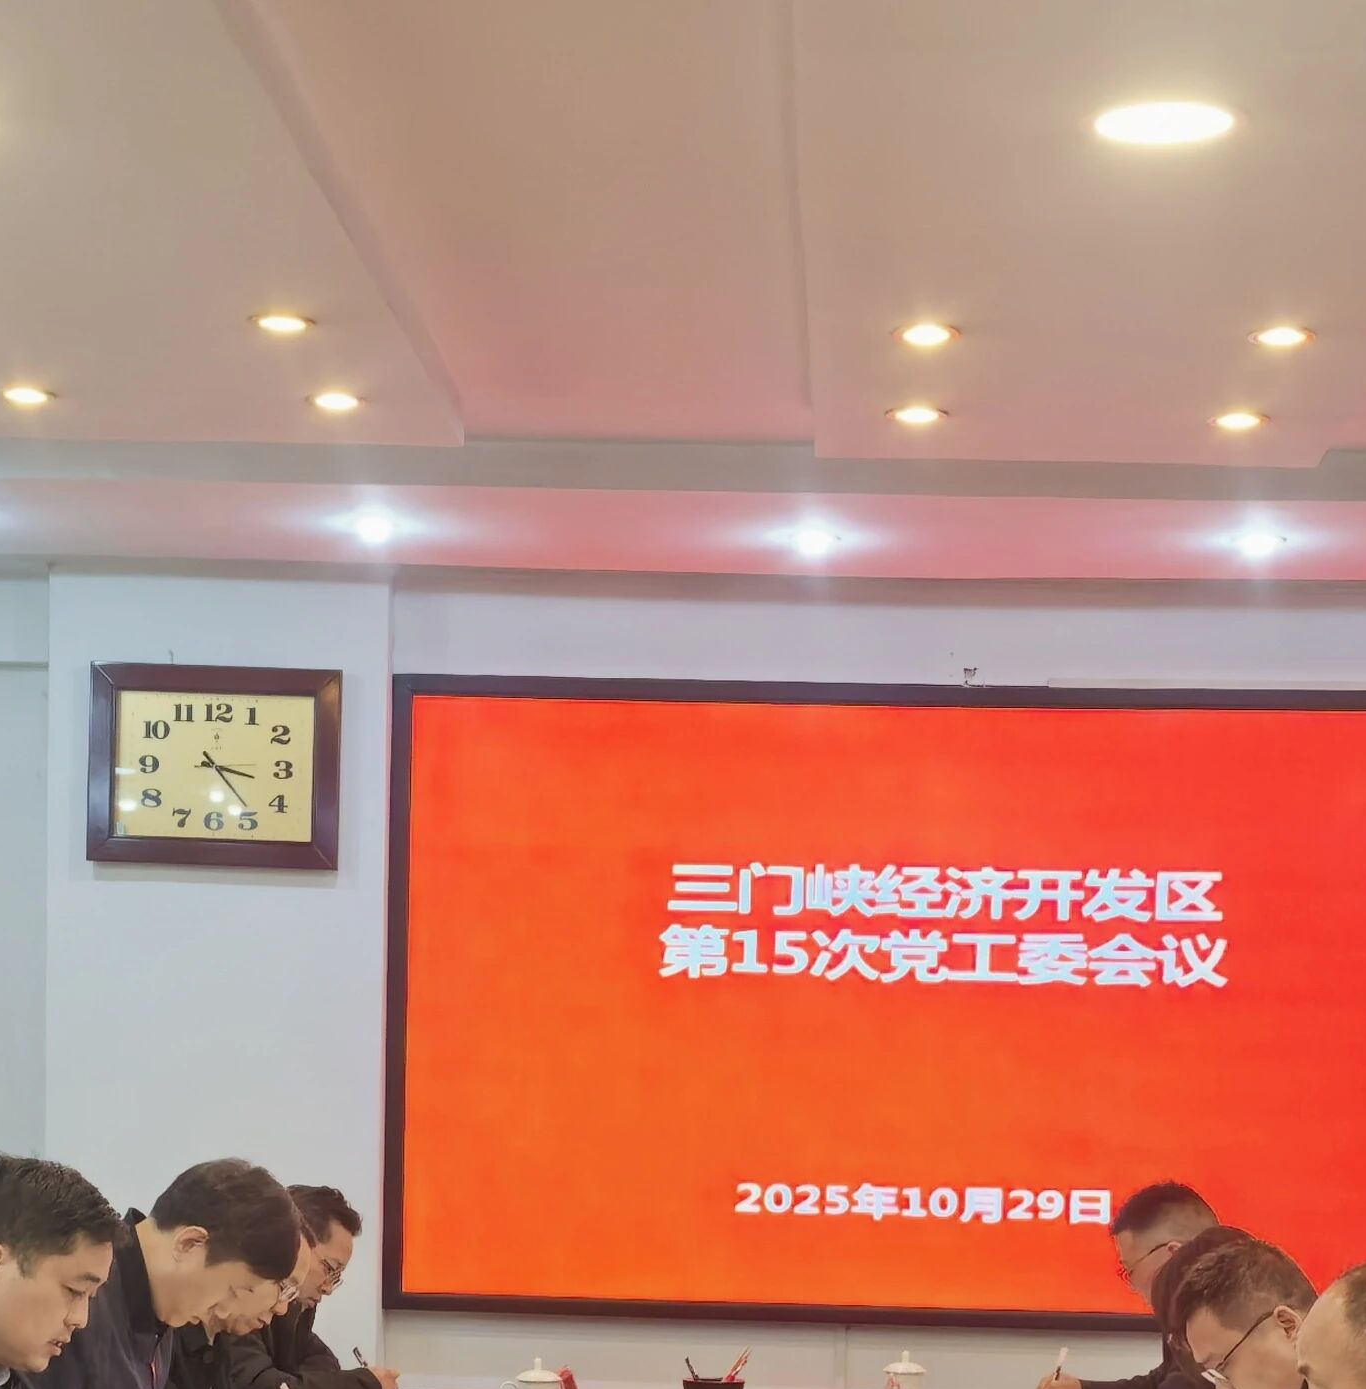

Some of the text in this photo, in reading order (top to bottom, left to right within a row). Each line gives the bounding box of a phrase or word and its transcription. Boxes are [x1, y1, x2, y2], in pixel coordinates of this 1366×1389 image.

[173, 704, 194, 722] 11
[204, 703, 233, 723] 12
[245, 707, 259, 725] 1
[143, 720, 170, 739] 10
[270, 725, 291, 744] 2
[139, 755, 159, 773] 9
[273, 760, 293, 779] 3
[141, 789, 162, 807] 8
[269, 794, 288, 813] 4
[172, 807, 191, 827] 7
[204, 811, 224, 831] 6
[238, 811, 258, 830] 5
[667, 862, 1223, 922] 三门峡经济开发区
[658, 924, 1228, 988] 第15次党工委会议
[734, 1182, 1112, 1225] 2025年10月29日
